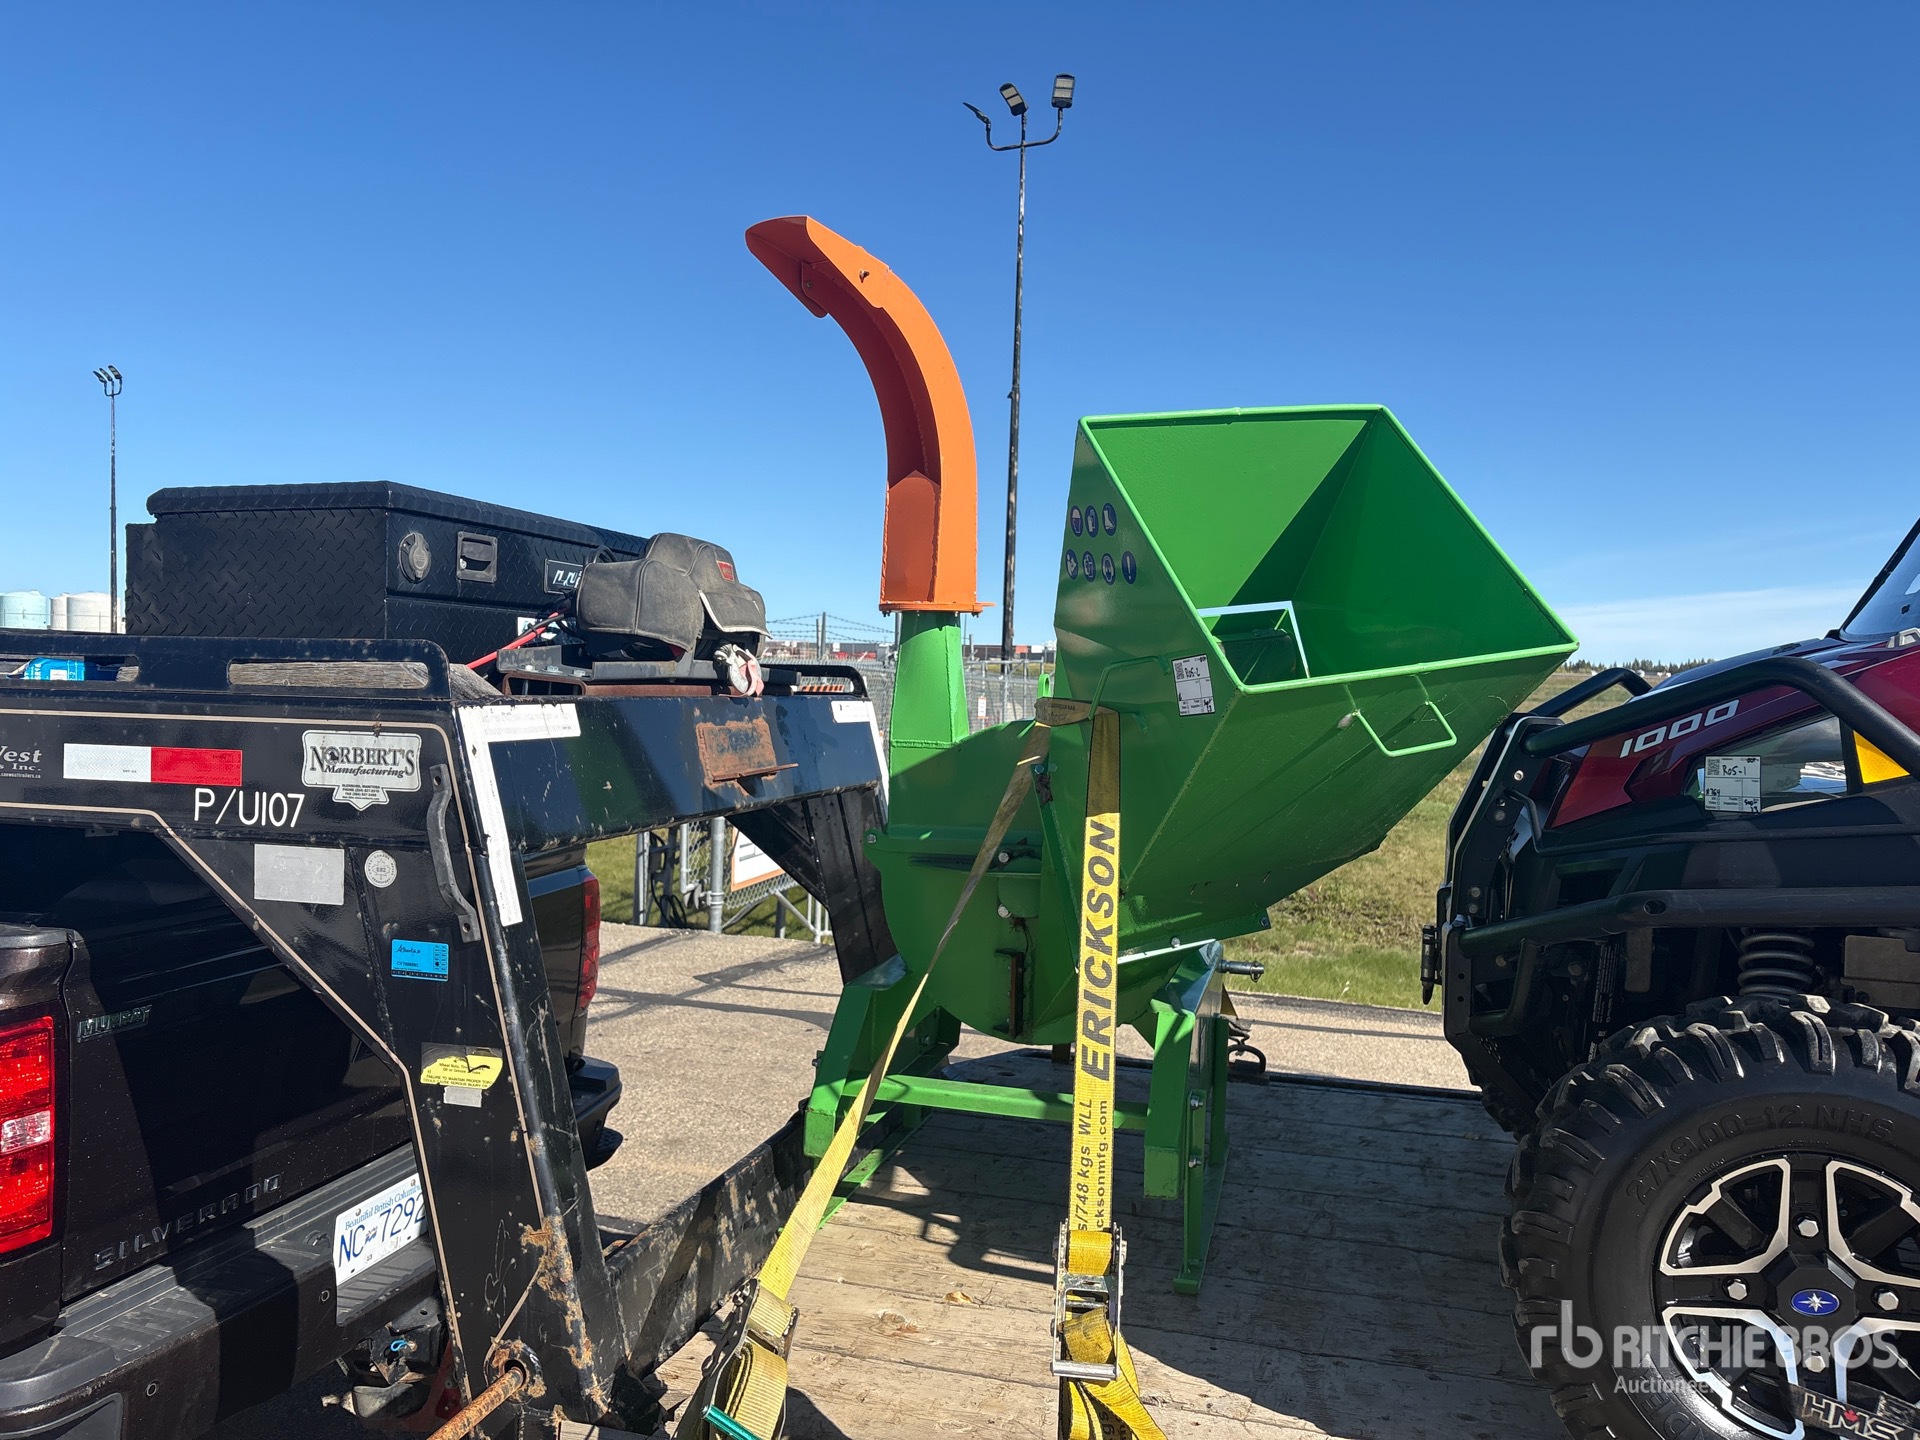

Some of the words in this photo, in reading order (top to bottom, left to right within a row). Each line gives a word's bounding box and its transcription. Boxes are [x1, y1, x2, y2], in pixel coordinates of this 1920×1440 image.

[1620, 699, 1740, 759] 1000
[12, 762, 41, 771] Inc.
[309, 745, 415, 776] NORBERT'S
[324, 764, 406, 778] Manufacturing
[1080, 819, 1116, 1082] ERICKSON
[1078, 1099, 1092, 1136] WLL
[1816, 1104, 1897, 1139] NHS
[1077, 1145, 1094, 1179] kgs
[94, 1174, 282, 1272] SILVERADO
[338, 1224, 366, 1268] NC
[379, 1192, 426, 1243] 7292
[344, 1207, 374, 1231] Beautiful
[373, 1196, 395, 1216] British
[1802, 1392, 1905, 1440] HMS
